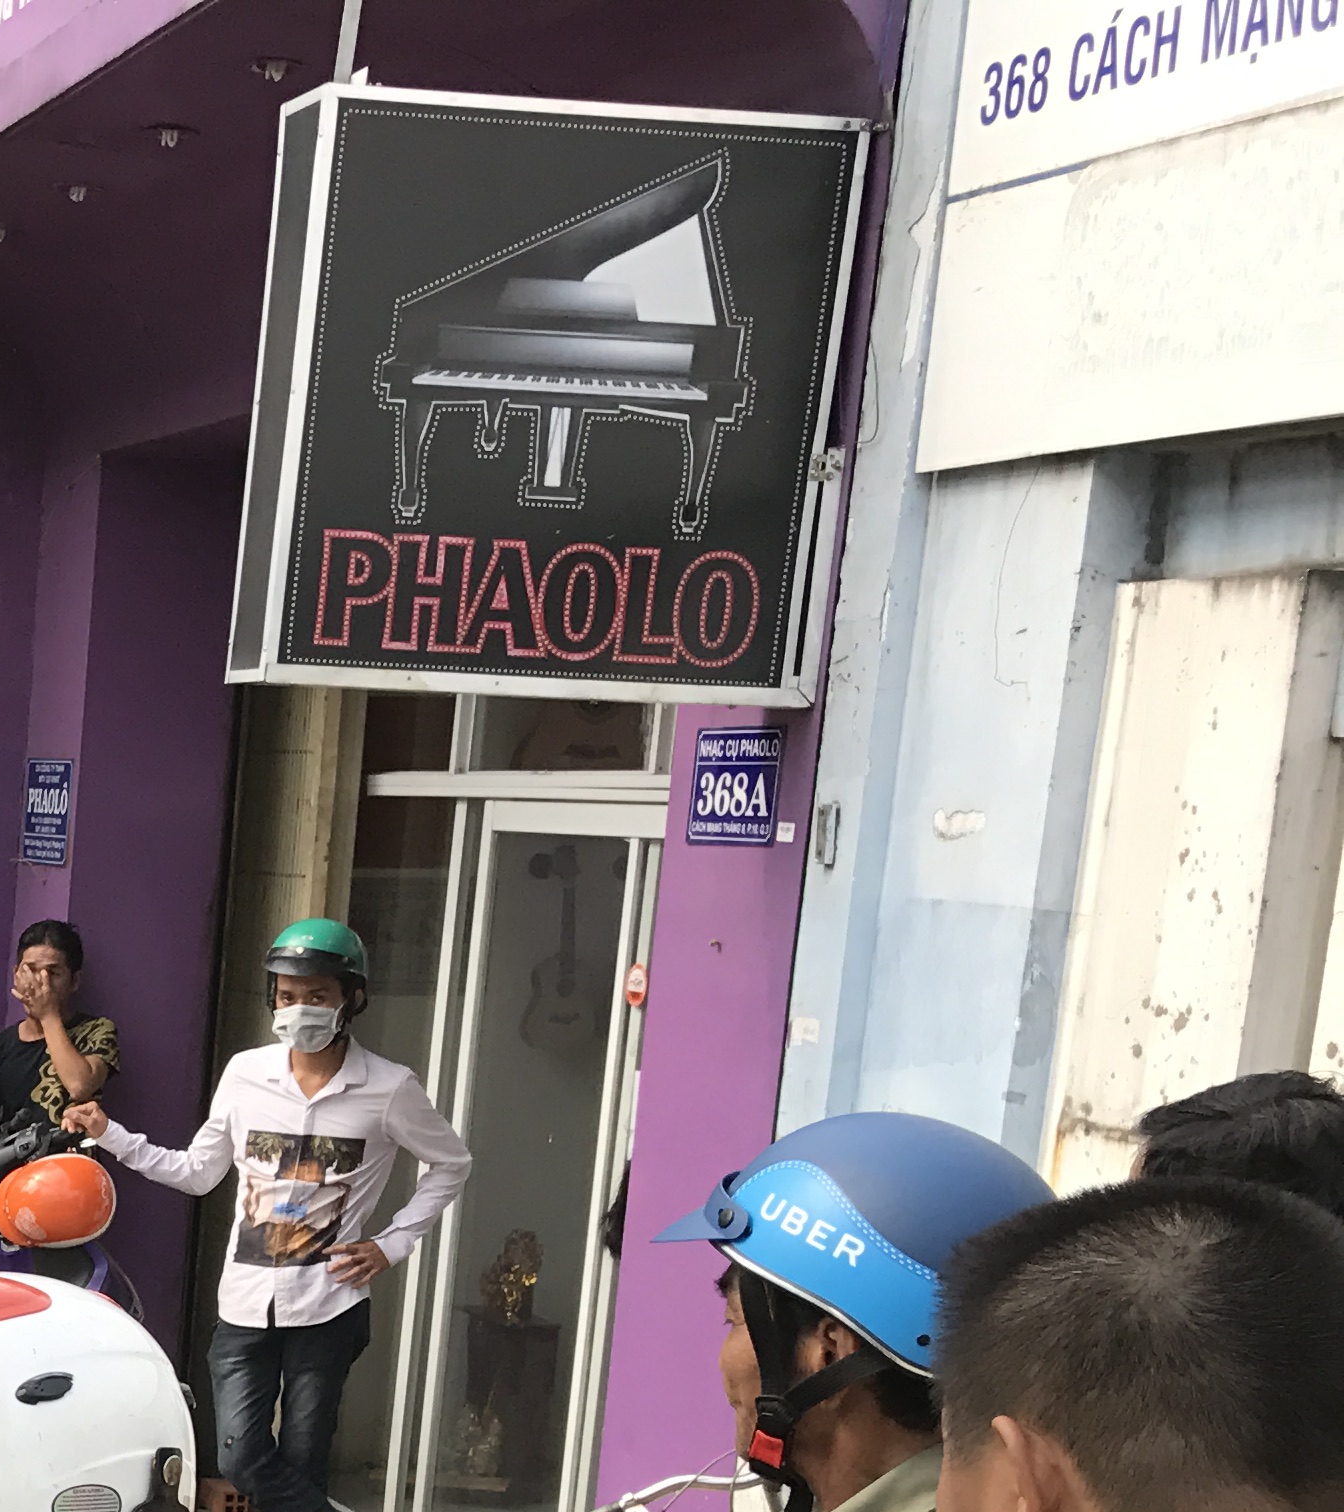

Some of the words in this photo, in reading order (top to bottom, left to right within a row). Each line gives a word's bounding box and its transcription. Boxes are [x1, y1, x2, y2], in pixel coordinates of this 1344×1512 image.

[980, 47, 1051, 126] 368
[1068, 4, 1182, 101] CÁCH
[313, 527, 760, 668] PHAOLO
[699, 740, 724, 761] NHẠC
[725, 739, 740, 761] CỤ
[740, 738, 779, 757] PHAOLO
[697, 772, 769, 817] 368A
[759, 1192, 866, 1268] UBER
